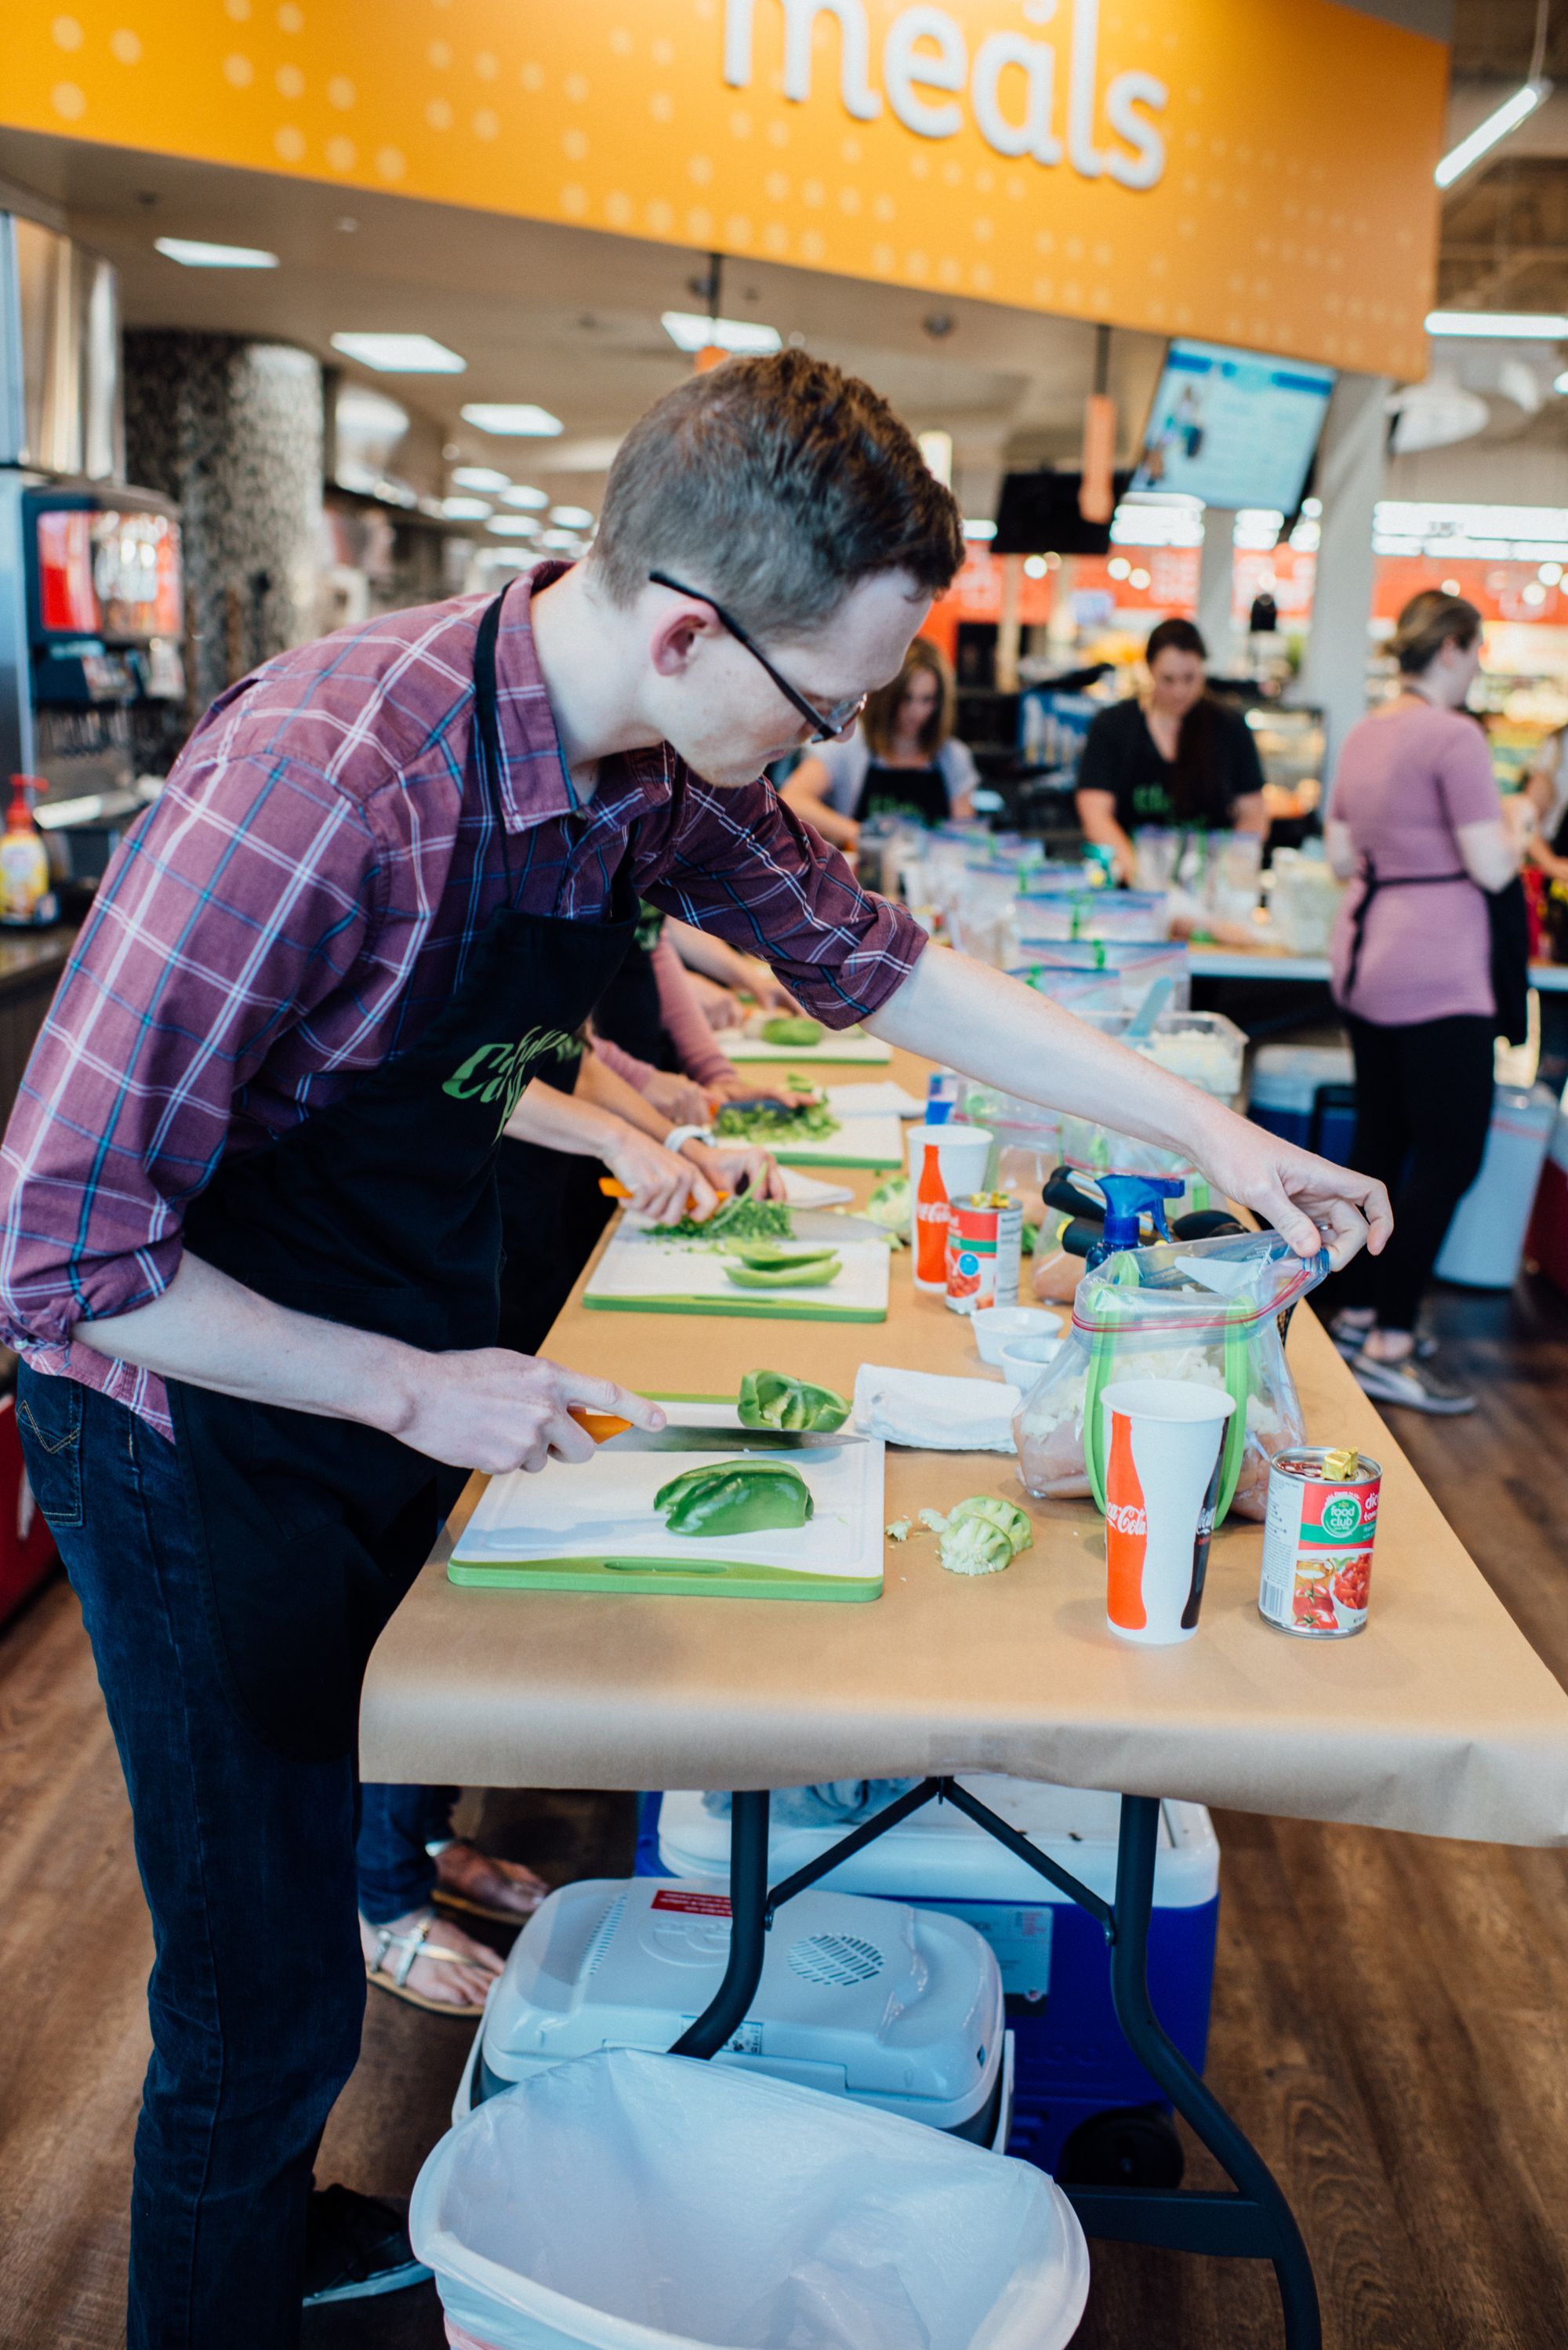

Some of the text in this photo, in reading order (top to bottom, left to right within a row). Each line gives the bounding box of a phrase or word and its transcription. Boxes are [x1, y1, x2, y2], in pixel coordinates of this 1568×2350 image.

[724, 0, 1169, 191] meals
[1330, 1505, 1355, 1517] food
[1330, 1515, 1353, 1527] club
